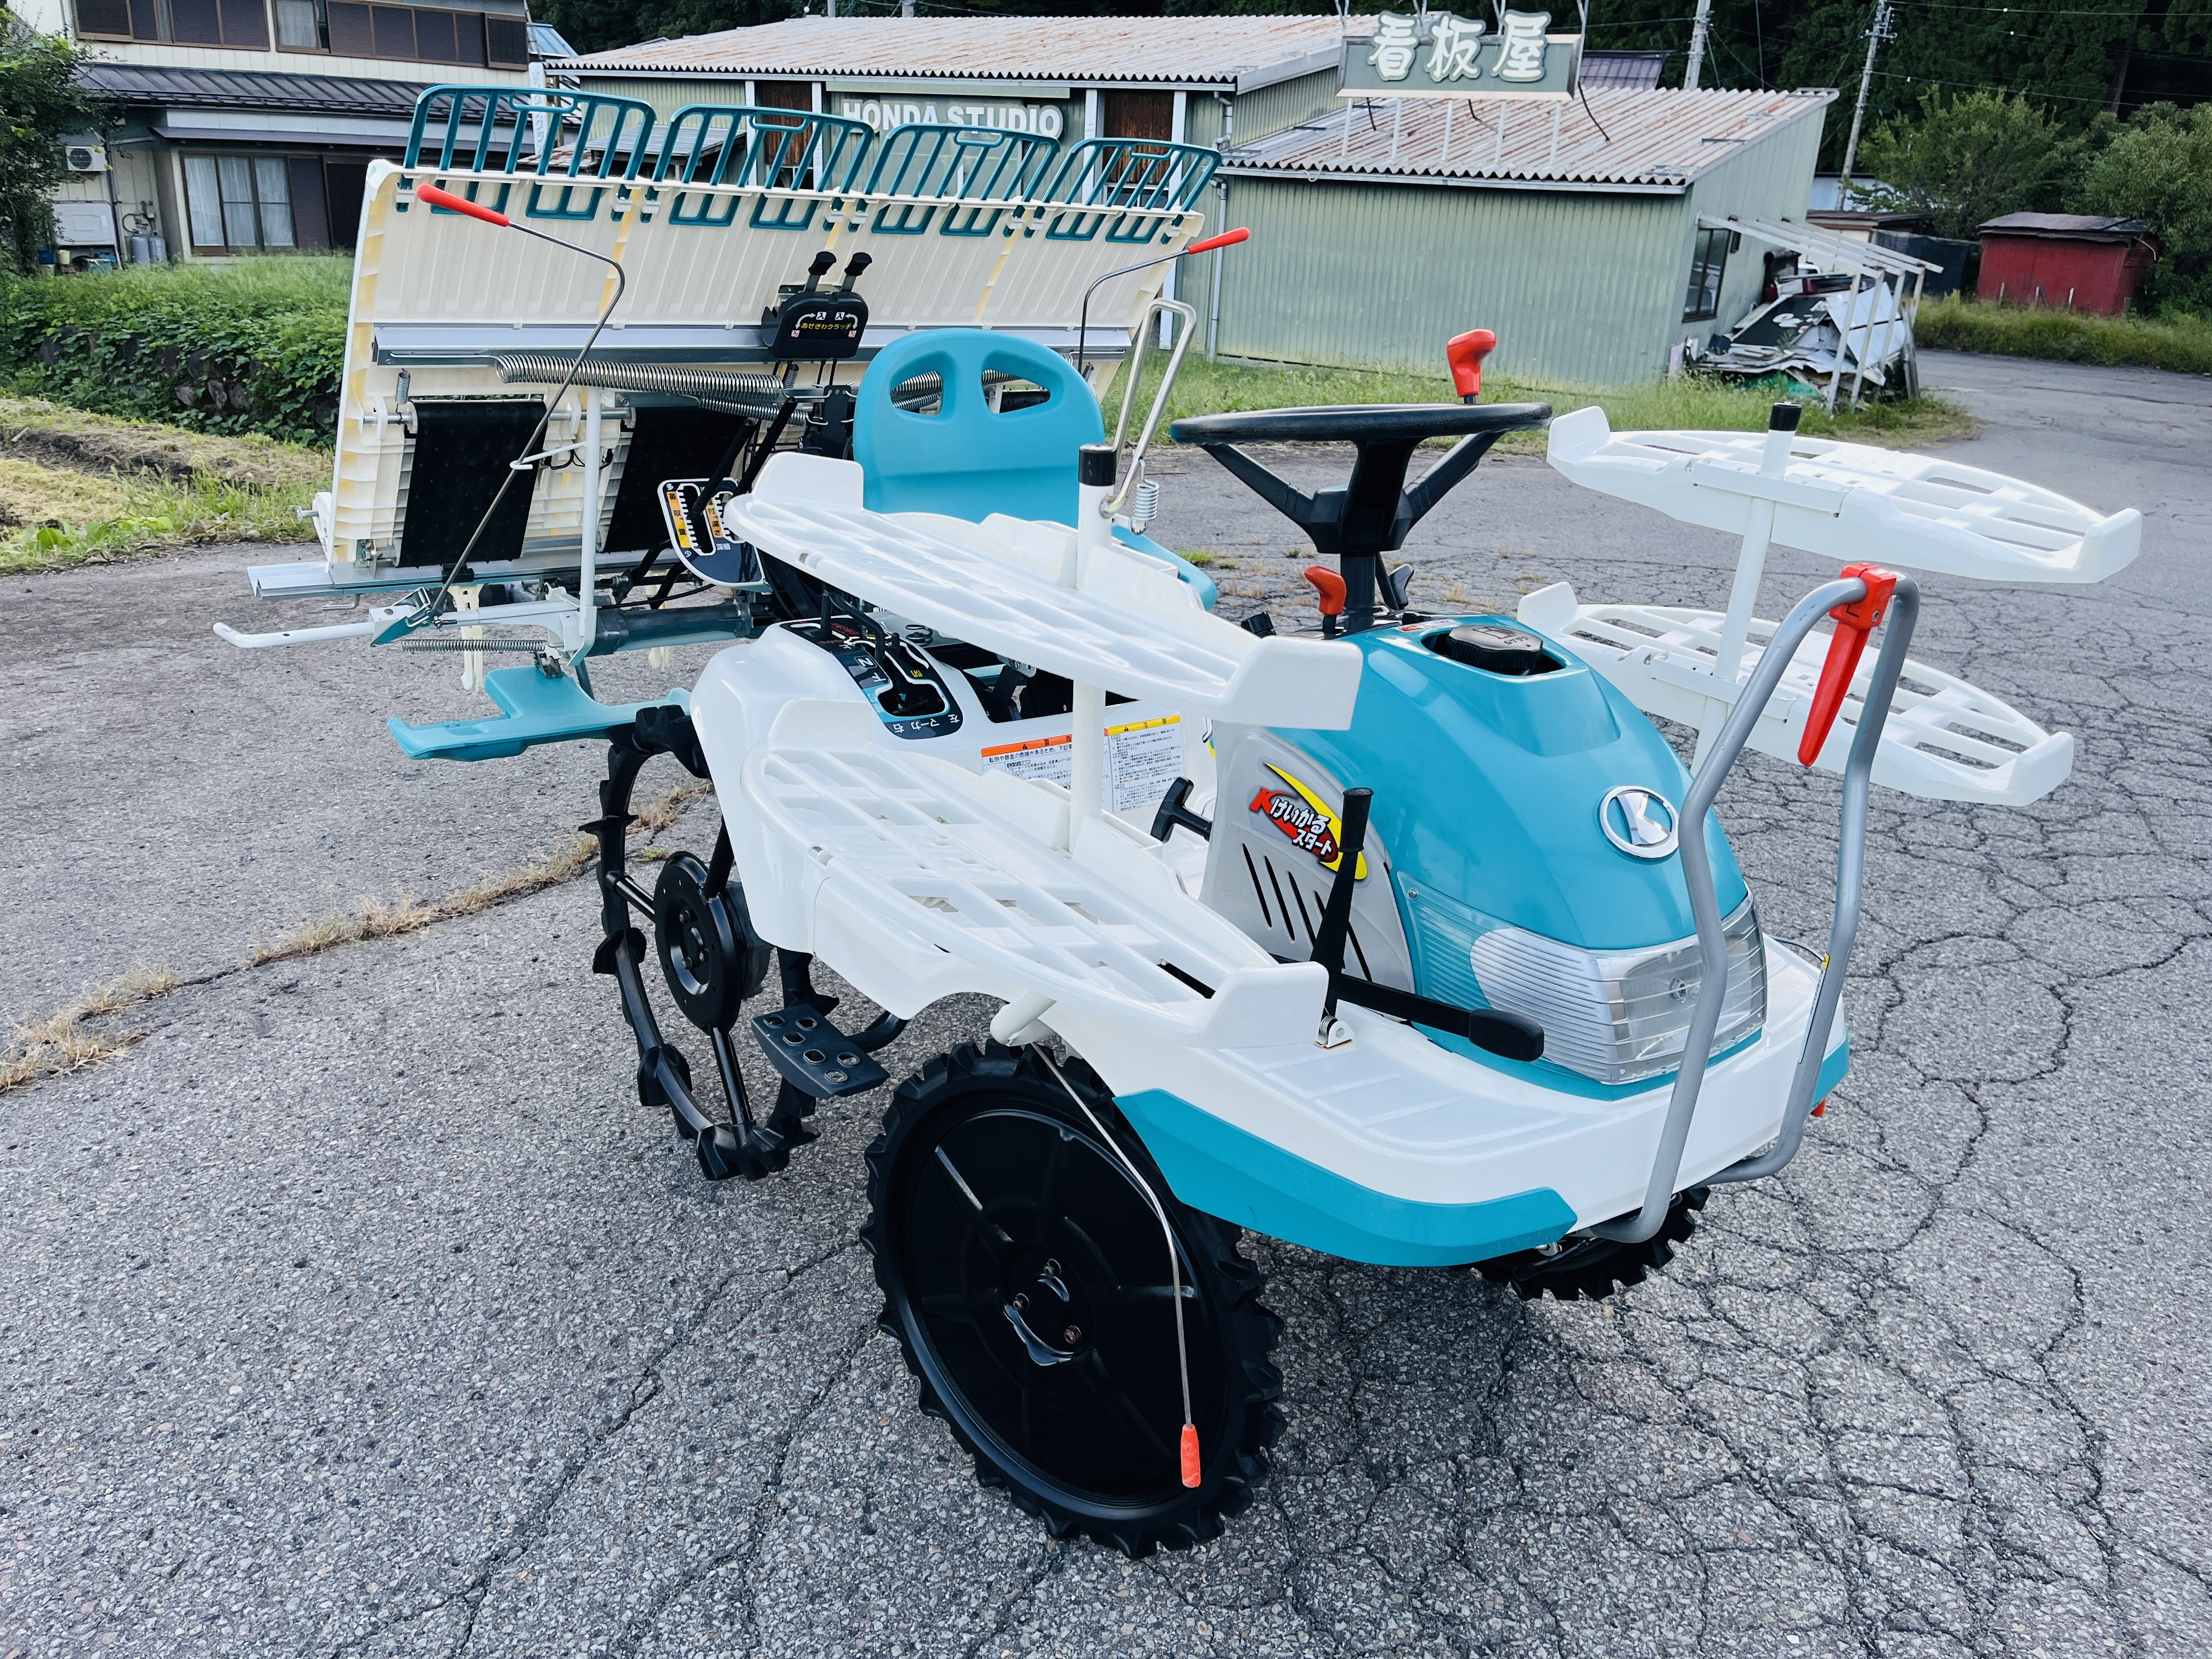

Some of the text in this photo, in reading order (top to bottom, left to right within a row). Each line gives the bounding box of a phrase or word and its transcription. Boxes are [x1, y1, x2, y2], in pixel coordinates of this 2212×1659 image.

[1369, 13, 1549, 77] 看板屋
[843, 102, 1060, 135] HONDA STUDIO
[893, 714, 960, 733] 左 マーカ 右
[1269, 798, 1330, 834] けいかる
[1292, 828, 1333, 856] スタート
